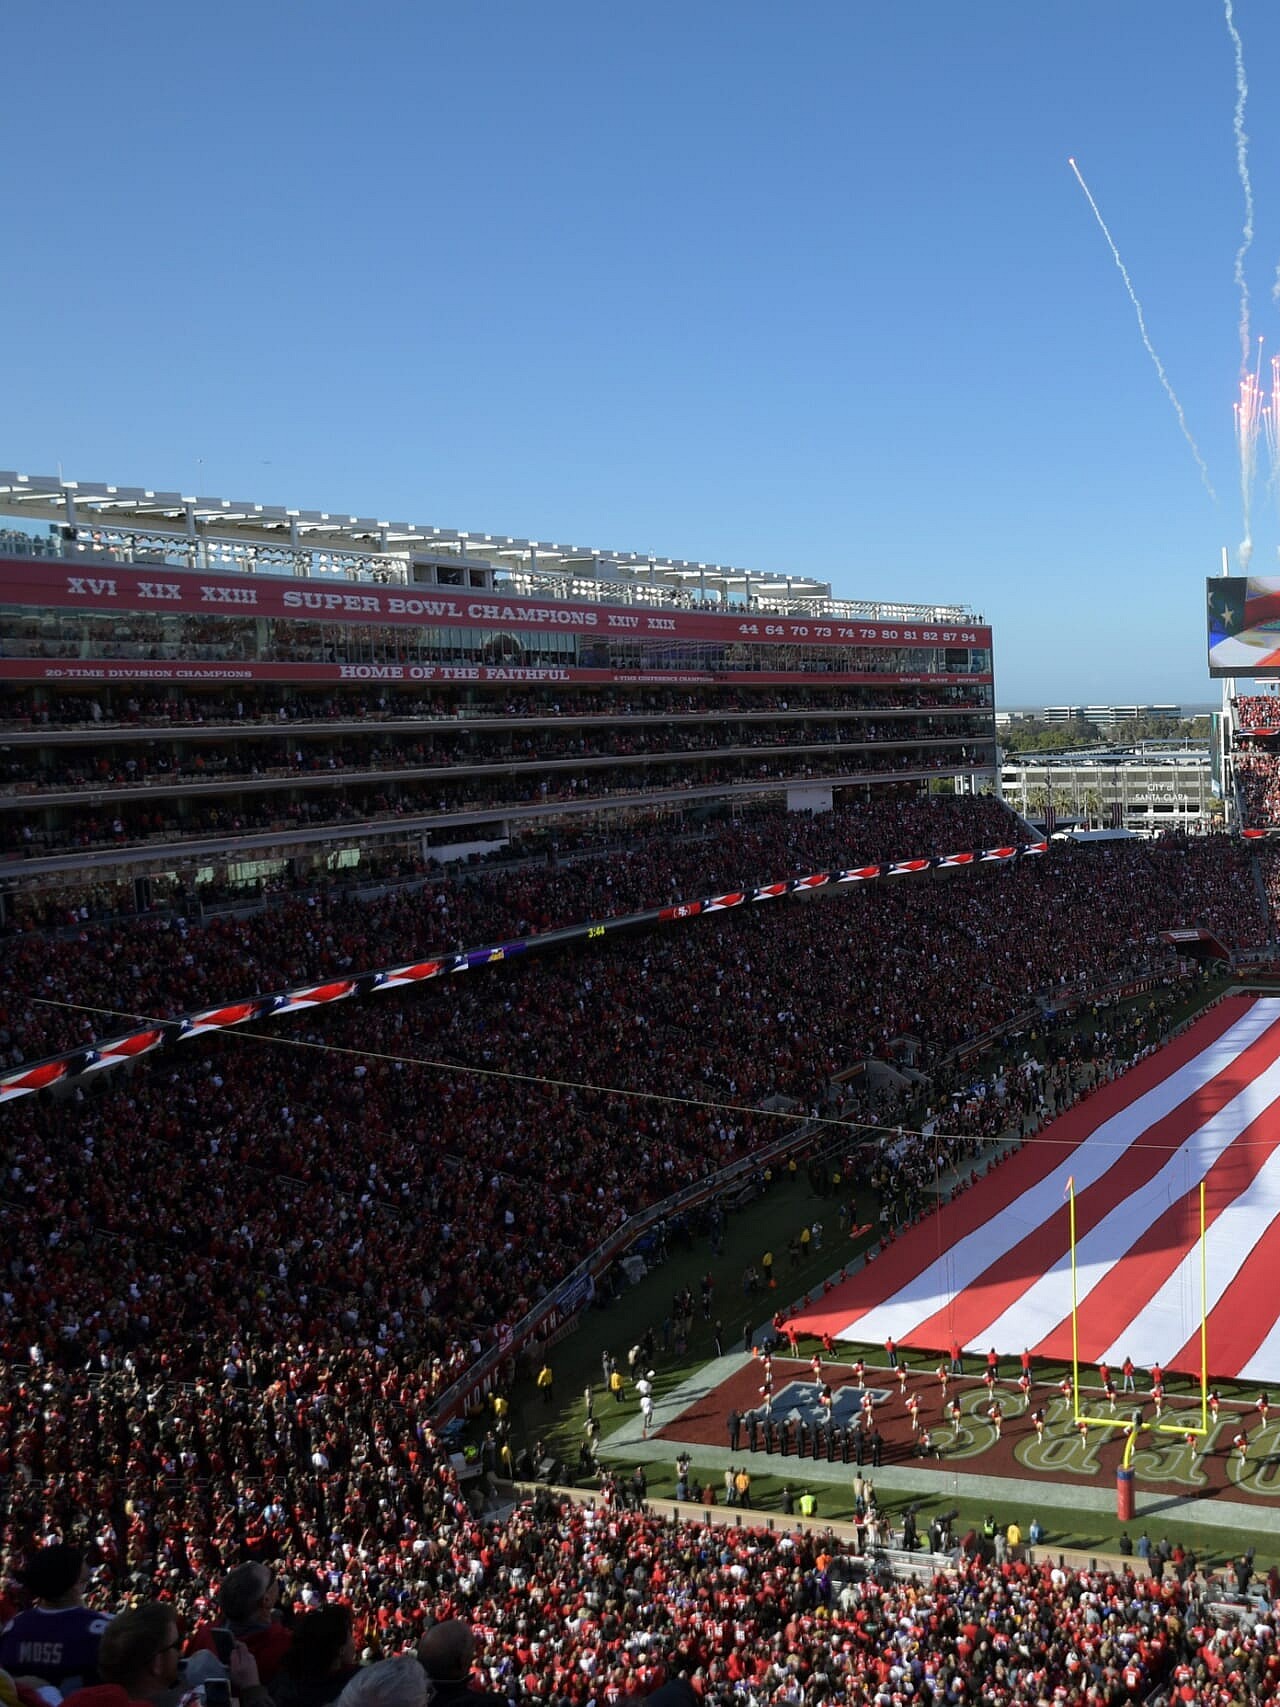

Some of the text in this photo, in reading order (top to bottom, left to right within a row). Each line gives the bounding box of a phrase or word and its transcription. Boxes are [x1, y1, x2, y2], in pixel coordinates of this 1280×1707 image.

[67, 577, 677, 630] XVI XIX XXIII SUPER BOWL CHAMPIONS XXIV XXIX
[739, 624, 976, 642] 44 64 70 73 74 79 80 81 82 87 94
[45, 669, 252, 678] 20-TIME DIVISION CHAMPIONS
[340, 665, 570, 680] HOME OF THE FAITHFUL
[1147, 783, 1164, 791] CITY
[1135, 793, 1188, 801] SANTA CLARA
[18, 1640, 64, 1664] MOSS
